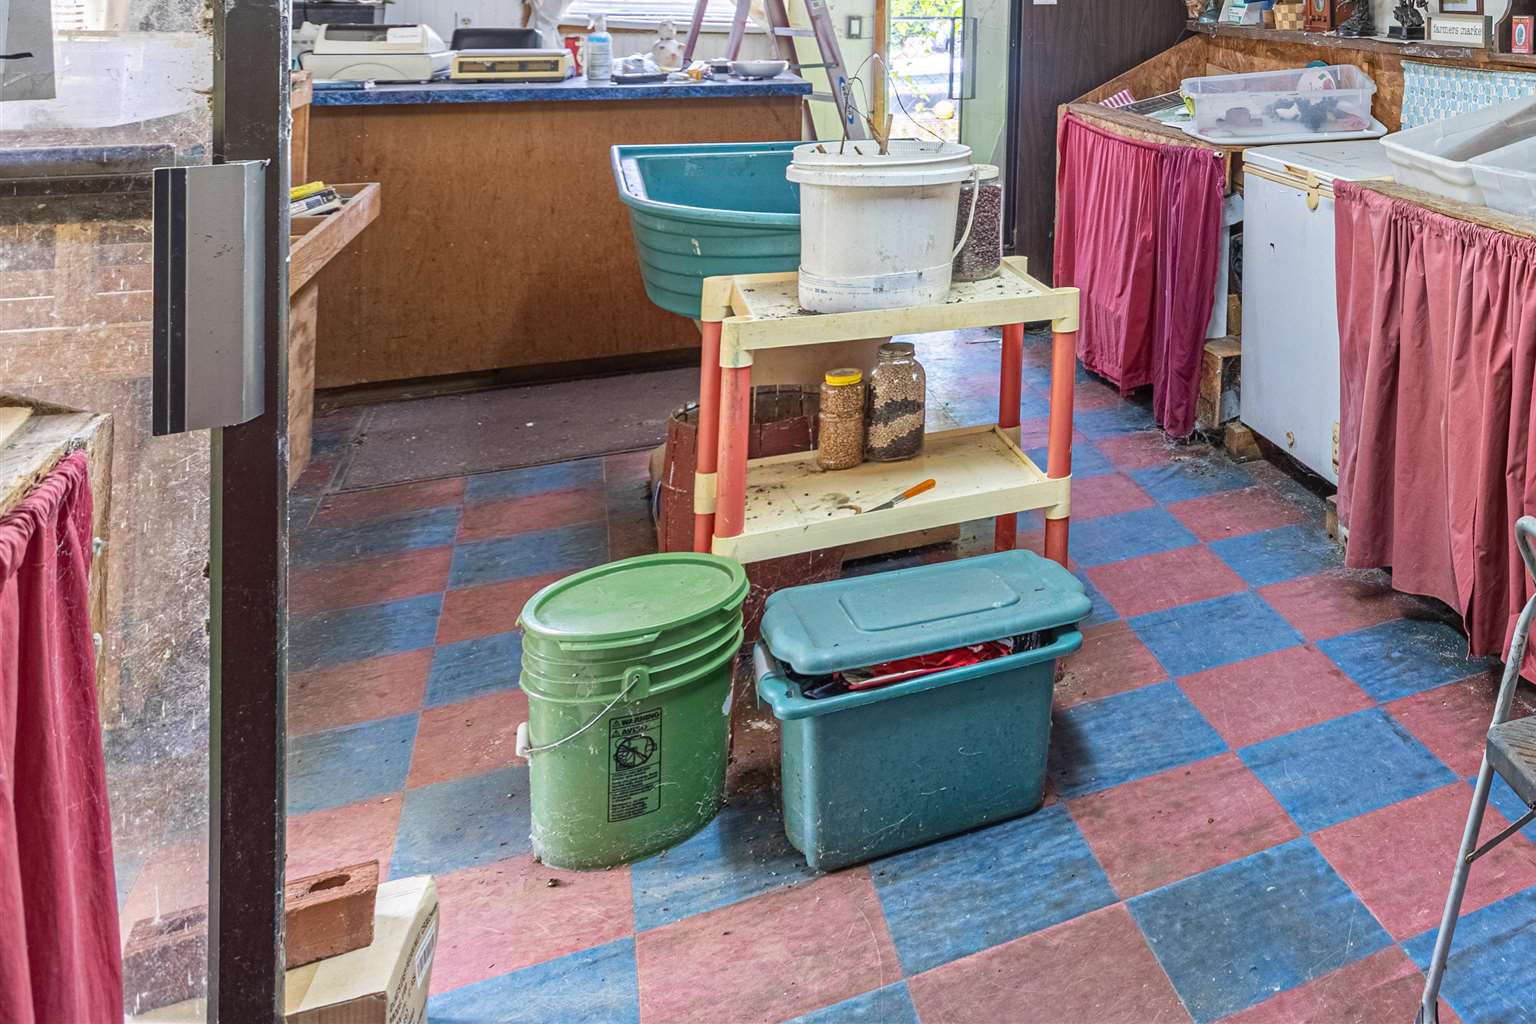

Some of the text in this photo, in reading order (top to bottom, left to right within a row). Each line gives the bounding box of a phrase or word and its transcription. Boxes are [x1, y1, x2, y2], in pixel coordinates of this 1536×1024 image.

[1433, 23, 1482, 36] farmers marke
[621, 711, 660, 726] WARNING
